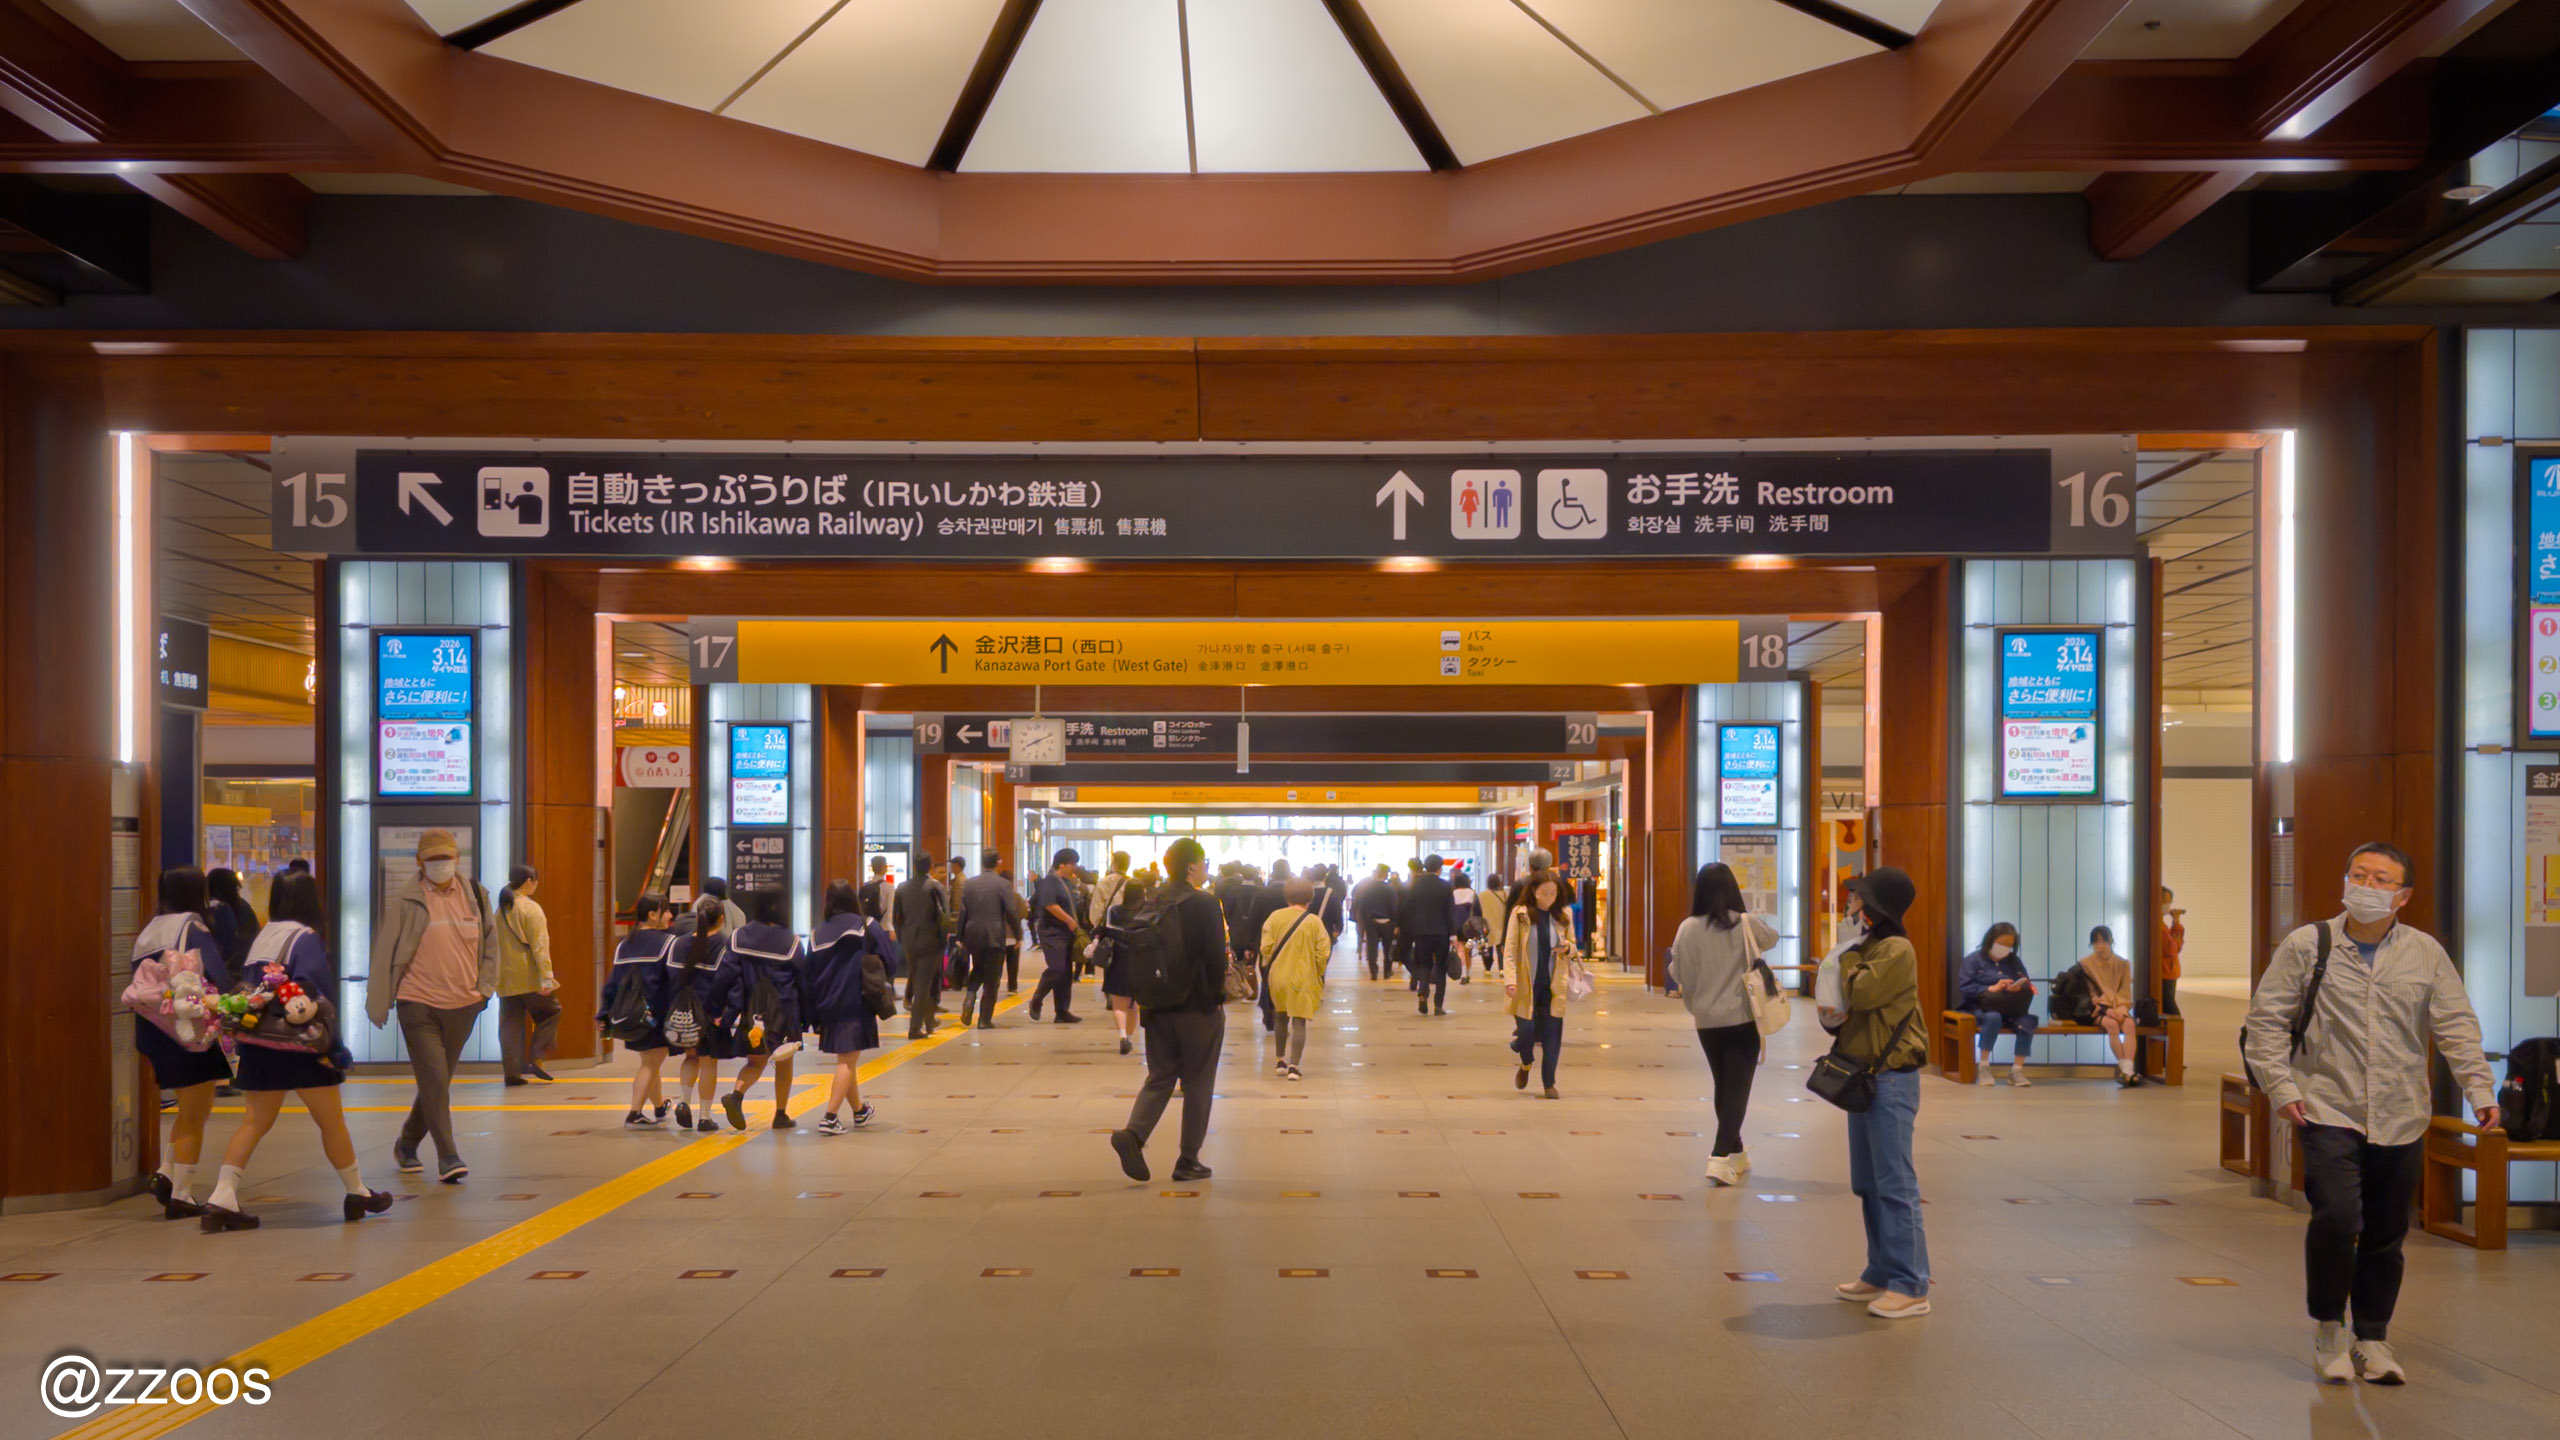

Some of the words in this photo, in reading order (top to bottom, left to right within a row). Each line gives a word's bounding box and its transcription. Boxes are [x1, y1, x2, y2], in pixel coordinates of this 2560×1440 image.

[568, 473, 847, 505] 自動きっぷうりば
[863, 479, 1102, 509] （IRいしかわ鉄道）
[1626, 472, 1739, 507] お手洗
[1758, 480, 1894, 506] Restroom
[282, 472, 348, 528] 15
[2058, 471, 2130, 529] 16
[569, 510, 654, 534] Tickets
[661, 509, 694, 537] (IR
[702, 510, 809, 536] Ishikawa
[818, 511, 924, 541] Railway)
[937, 516, 1043, 537] 승차권판매기
[1054, 517, 1104, 537] 售票机
[1116, 517, 1167, 537] 售票機
[1627, 513, 1682, 536] 화장실
[1695, 514, 1755, 534] 洗手间
[1768, 514, 1829, 534] 洗手間
[2539, 531, 2560, 549] 地
[1468, 631, 1492, 641] バス
[2064, 637, 2086, 646] 2026
[693, 635, 734, 670] 17
[975, 635, 1064, 655] 金沢港口
[1072, 638, 1124, 656] （西口）
[1743, 634, 1784, 669] 18
[432, 648, 467, 666] 3.14
[1468, 657, 1517, 667] タクシー
[2057, 646, 2093, 664] 3.14
[975, 659, 1040, 672] Kanazawa
[1044, 659, 1071, 672] Port
[1075, 659, 1106, 672] Gate
[1112, 658, 1150, 673] (West
[1153, 658, 1188, 673] Gate)
[916, 722, 942, 744] 19
[1066, 722, 1094, 736] 手洗
[1101, 725, 1148, 736] Restroom
[1568, 723, 1596, 744] 20
[765, 734, 786, 745] 3.14
[1753, 734, 1776, 745] 3.14
[1009, 767, 1024, 778] 21
[1554, 766, 1570, 777] 22
[1481, 791, 1494, 799] 24
